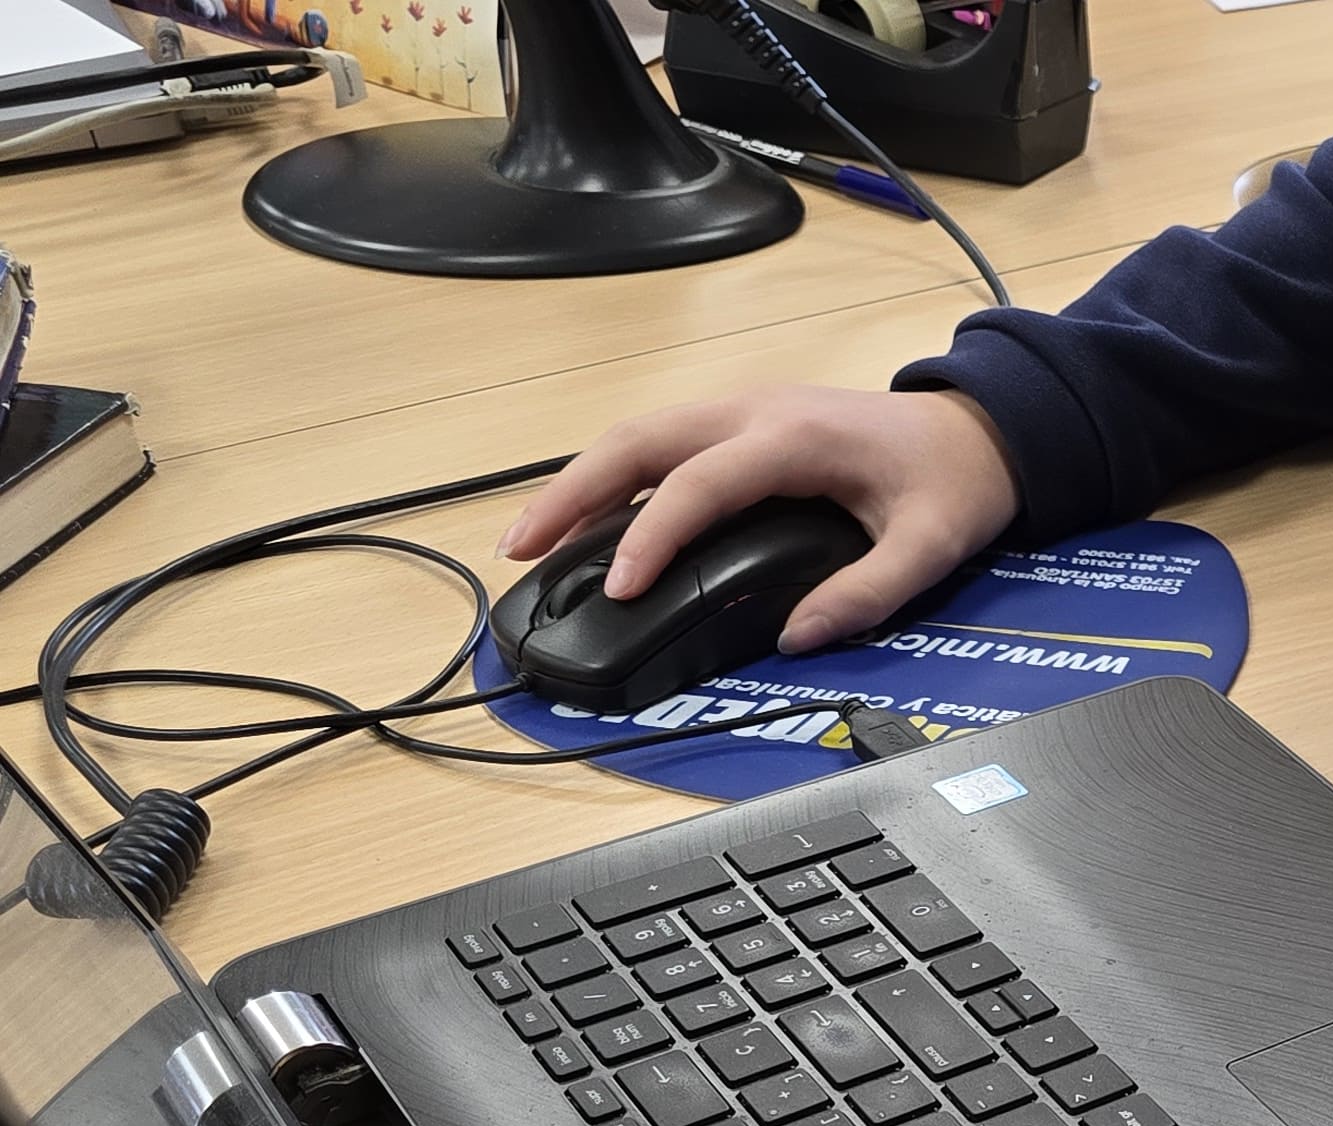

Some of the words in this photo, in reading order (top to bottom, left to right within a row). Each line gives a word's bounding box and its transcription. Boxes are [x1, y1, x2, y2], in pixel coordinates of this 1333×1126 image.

[1033, 566, 1128, 584] SANTIAGO
[1073, 577, 1090, 588] la
[1093, 580, 1117, 590] de
[1119, 581, 1181, 595] Campo
[898, 697, 932, 713] y
[931, 700, 1031, 728] ática
